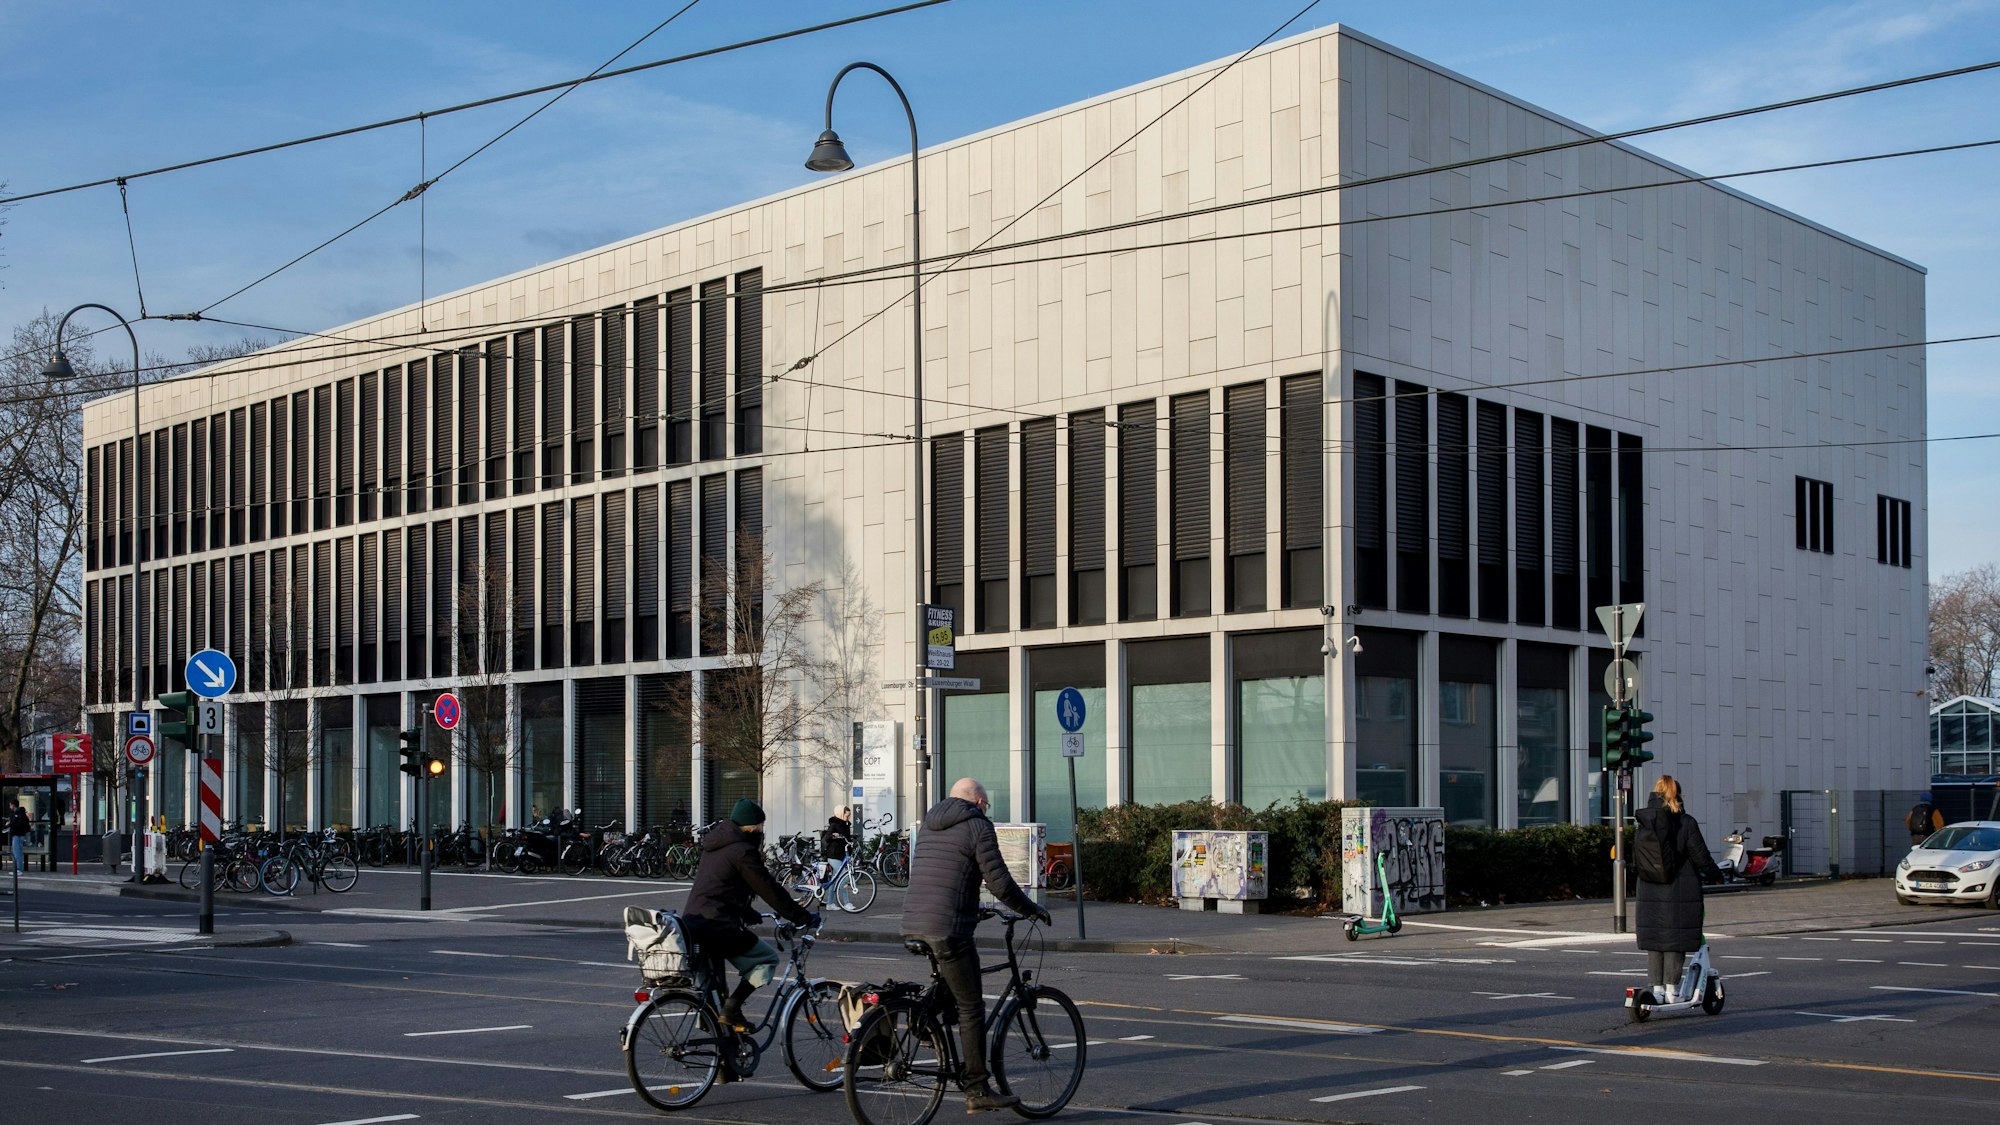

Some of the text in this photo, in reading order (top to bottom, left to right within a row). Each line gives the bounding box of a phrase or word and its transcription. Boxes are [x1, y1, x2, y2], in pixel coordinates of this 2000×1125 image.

[928, 608, 953, 620] FITNESS
[881, 682, 906, 690] Luxemburger
[931, 679, 962, 688] Luxemburger
[206, 707, 216, 729] 3
[863, 757, 881, 766] COPT
